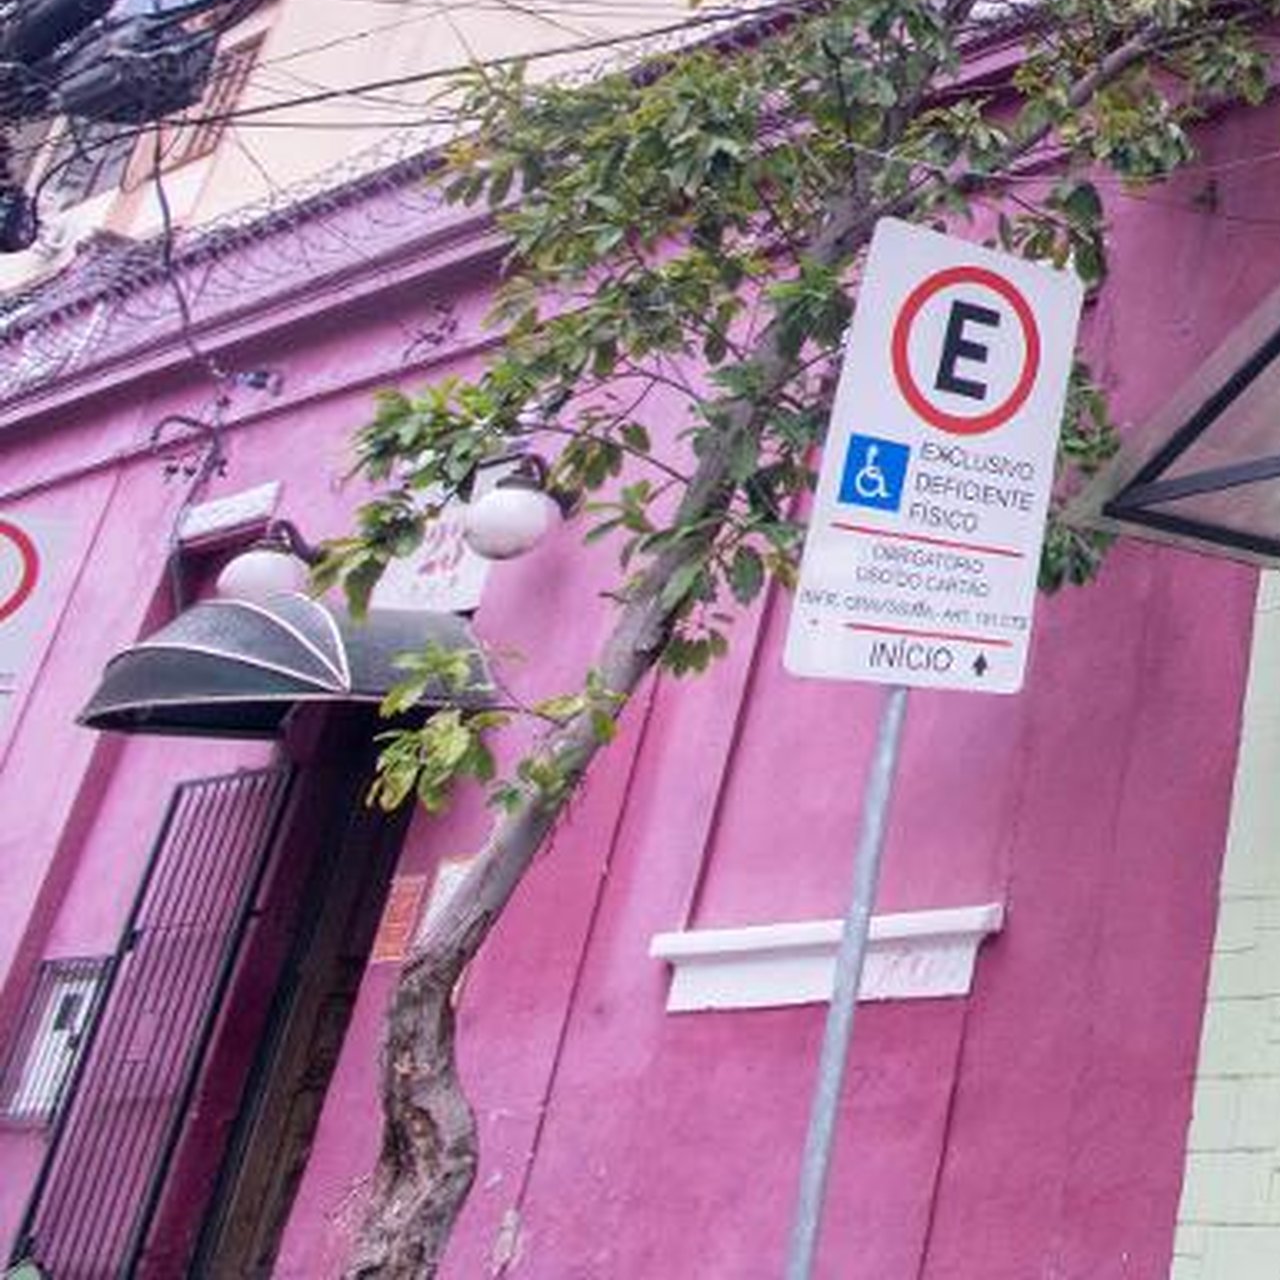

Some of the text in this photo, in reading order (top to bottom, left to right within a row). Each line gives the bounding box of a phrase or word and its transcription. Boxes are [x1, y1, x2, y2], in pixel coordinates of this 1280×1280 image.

[933, 299, 1000, 402] E
[920, 441, 1035, 481] EXCLUSIVO
[914, 472, 1036, 511] DEFICIENTE
[908, 499, 978, 533] FÍSICO
[868, 639, 954, 671] INÍCIO
